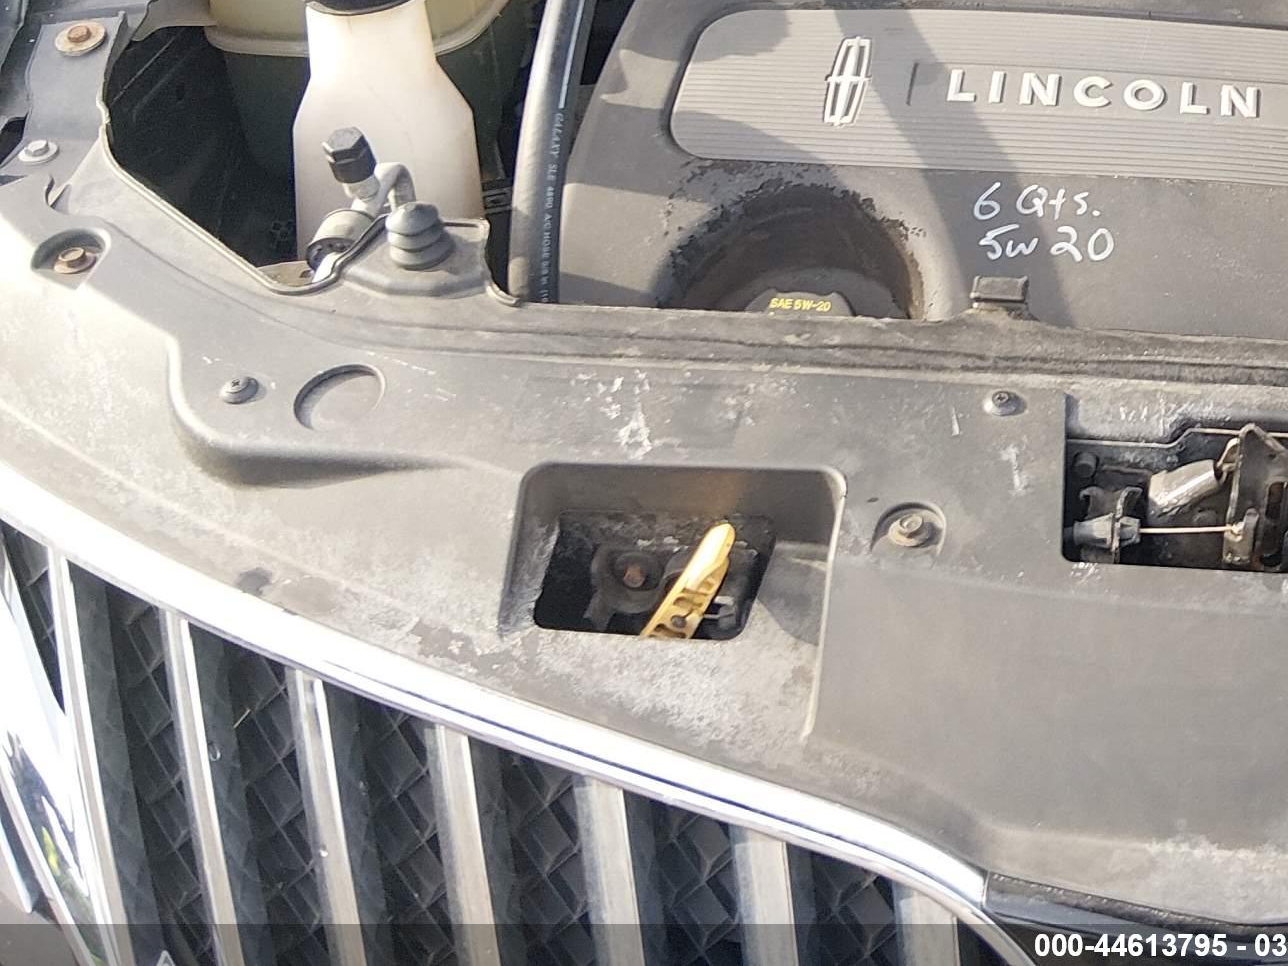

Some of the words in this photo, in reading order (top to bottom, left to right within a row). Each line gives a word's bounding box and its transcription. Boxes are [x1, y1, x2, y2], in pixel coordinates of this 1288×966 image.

[946, 68, 1262, 119] LINCOLN
[549, 112, 565, 158] GALAXY
[973, 181, 1001, 221] 6
[1015, 184, 1101, 220] Qts.
[768, 297, 793, 310] SAE
[793, 299, 832, 313] 5W-20
